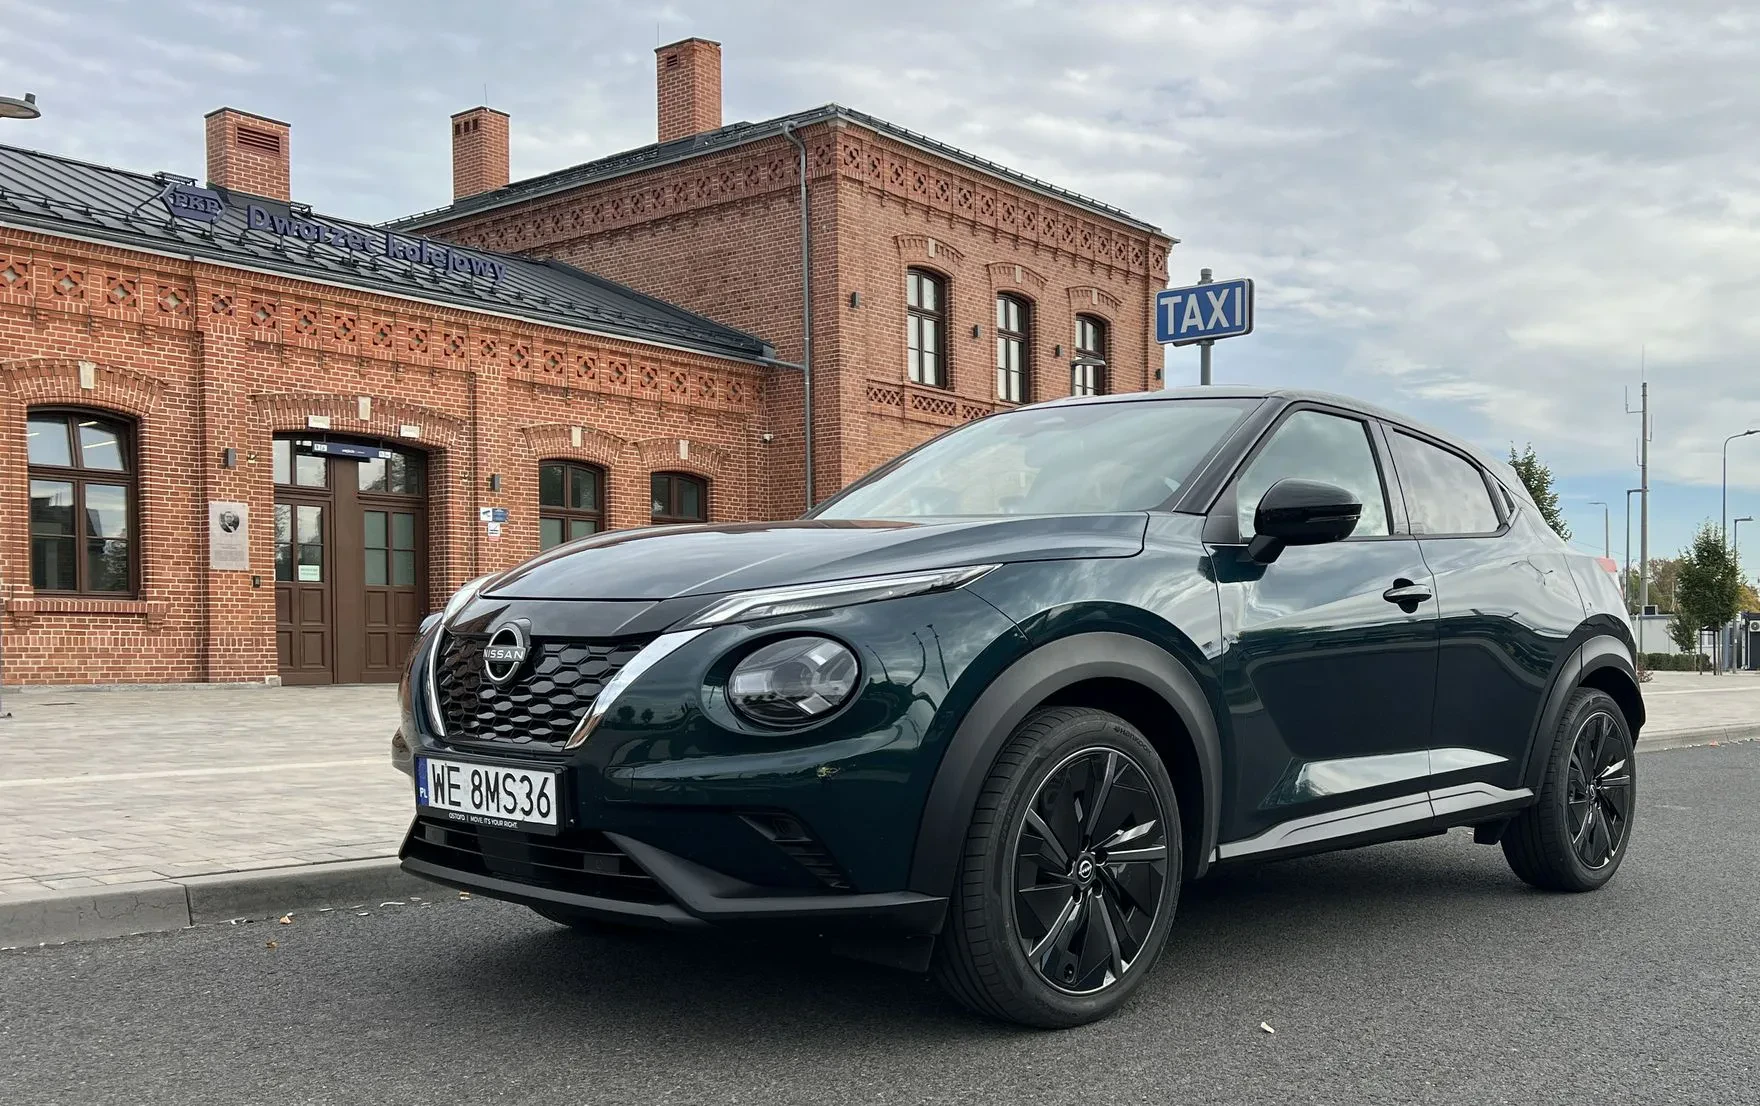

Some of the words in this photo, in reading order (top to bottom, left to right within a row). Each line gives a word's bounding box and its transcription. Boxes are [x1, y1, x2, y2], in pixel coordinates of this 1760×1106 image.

[174, 194, 221, 214] PKP
[247, 204, 378, 251] Dworzec
[385, 231, 508, 285] kolejowy
[1160, 286, 1242, 335] TAXI
[483, 648, 524, 660] NISSAN
[419, 786, 428, 799] PL
[431, 763, 462, 807] WE
[470, 769, 551, 819] 8MS36
